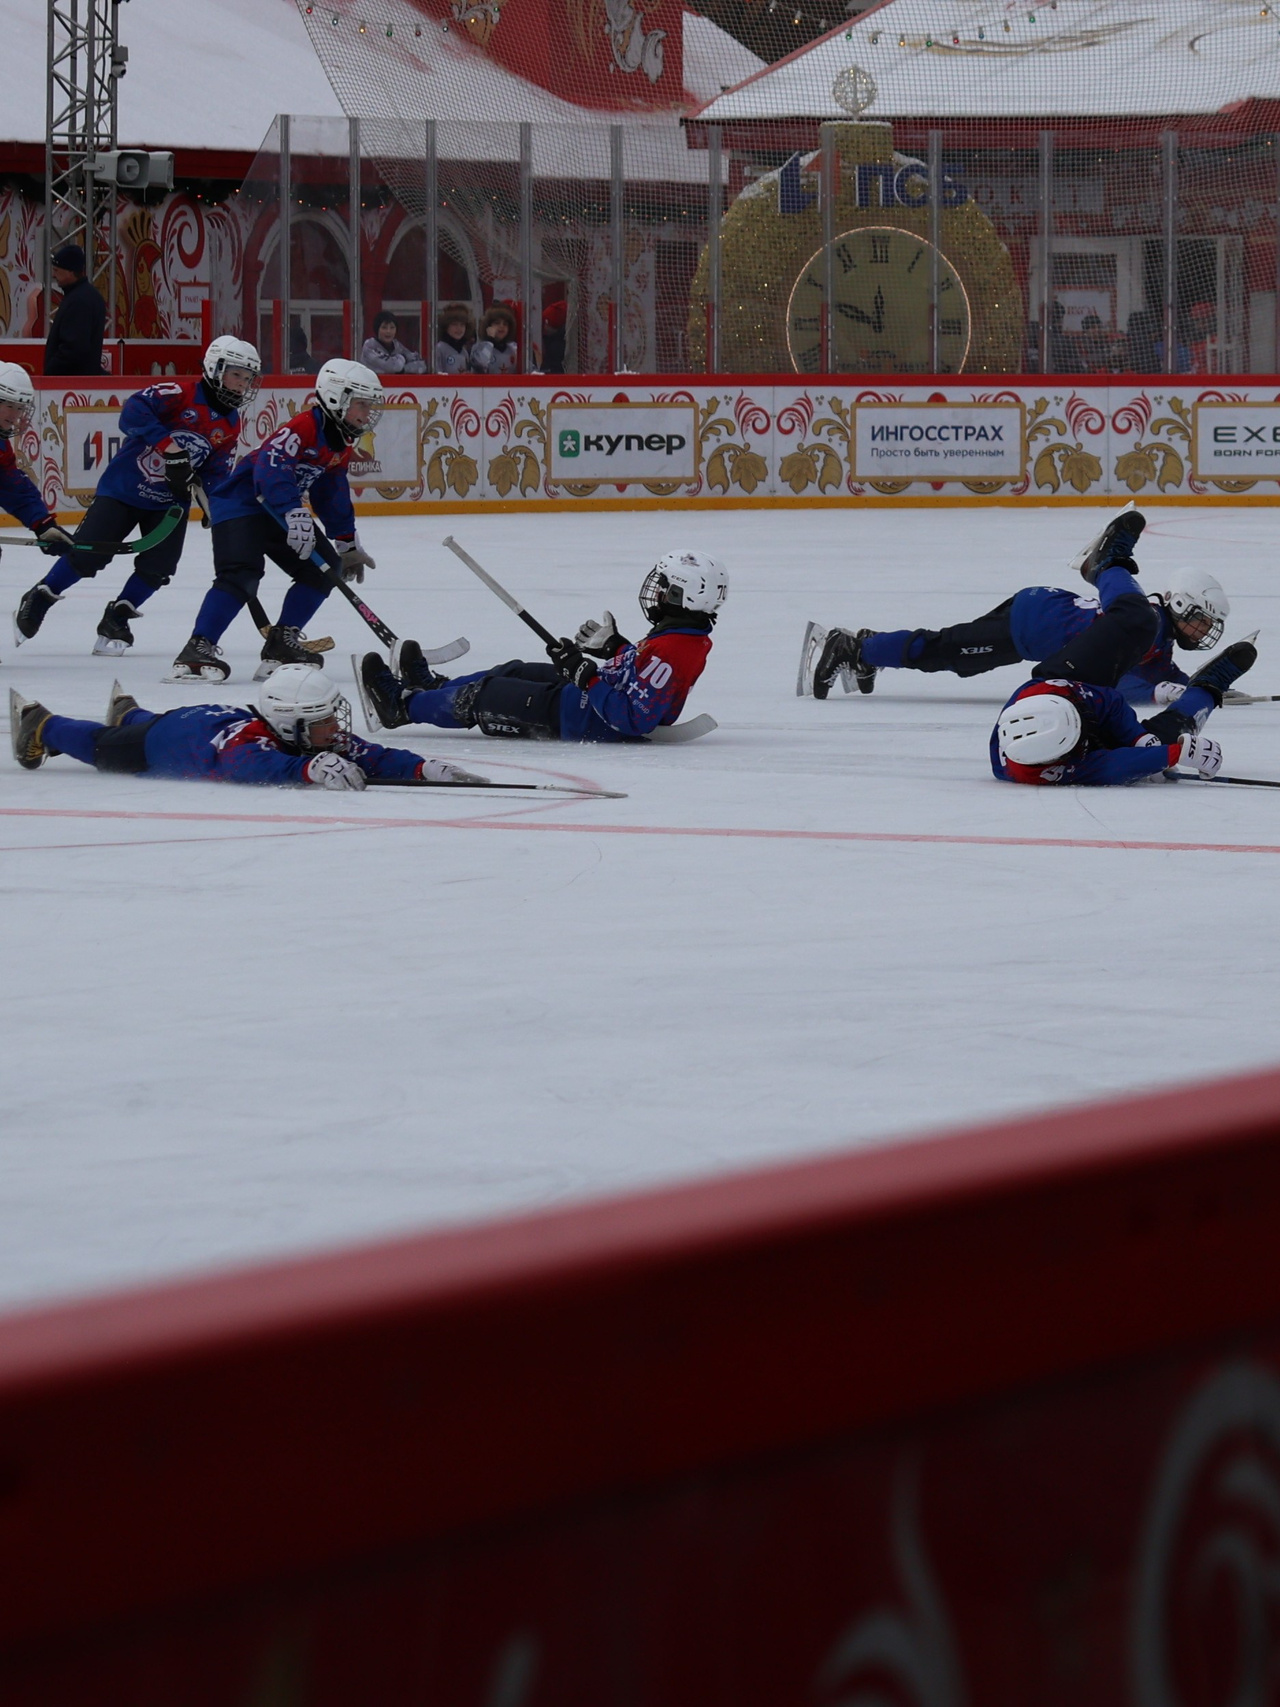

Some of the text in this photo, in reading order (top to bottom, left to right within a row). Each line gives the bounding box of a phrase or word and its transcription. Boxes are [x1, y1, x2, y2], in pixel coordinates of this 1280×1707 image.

[854, 163, 968, 207] ПСБ
[871, 425, 1004, 442] ИНГОССТРАХ
[270, 426, 302, 457] 26
[584, 434, 686, 456] купер
[870, 447, 1005, 458] Просто быть уверенным
[1213, 449, 1252, 457] BORN
[960, 645, 994, 655] STEX
[488, 722, 520, 734] STEX
